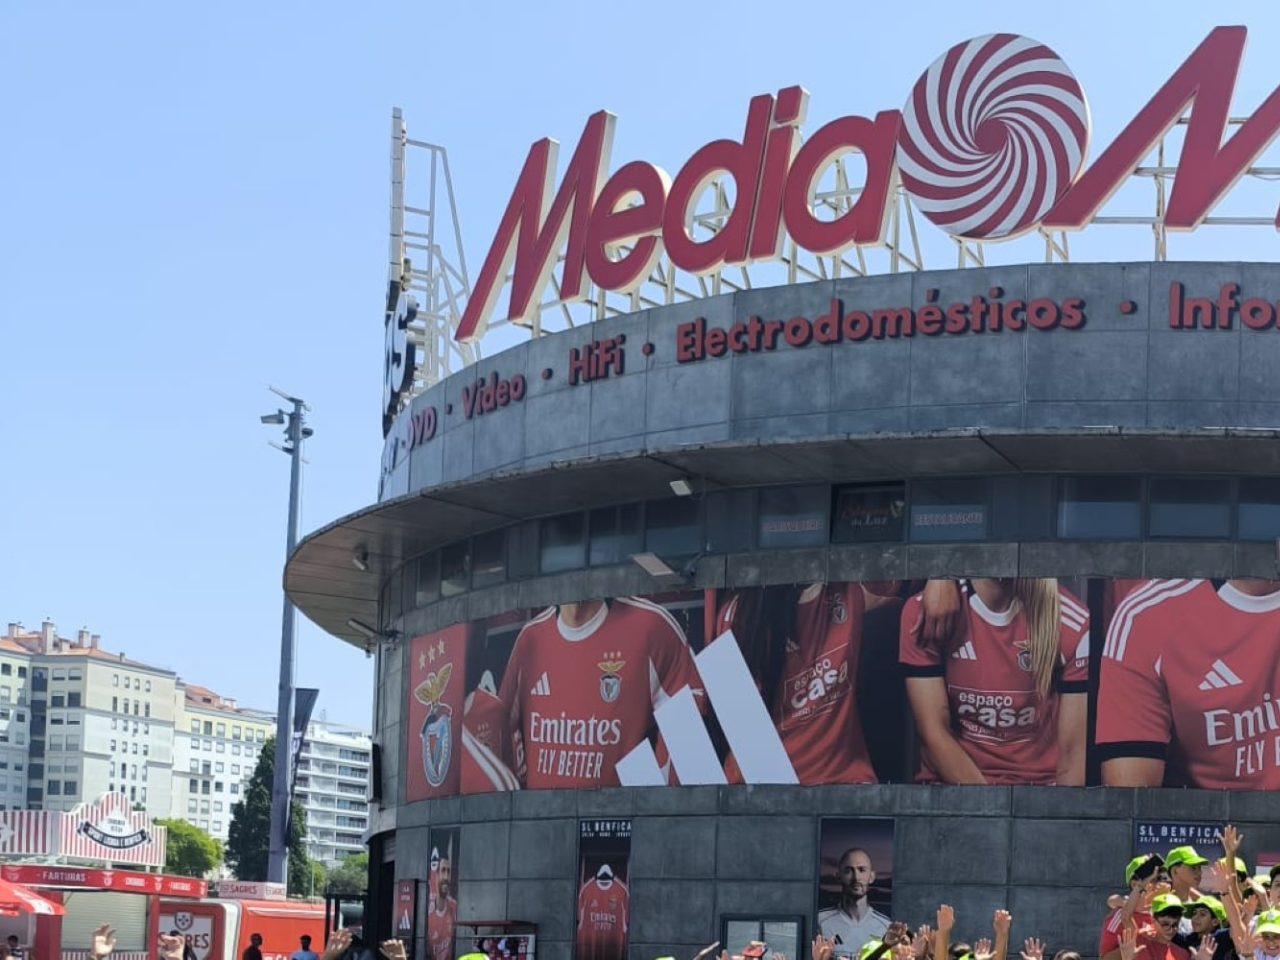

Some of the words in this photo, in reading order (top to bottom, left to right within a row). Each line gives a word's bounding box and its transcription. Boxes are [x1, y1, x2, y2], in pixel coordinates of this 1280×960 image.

[455, 84, 902, 341] Media
[568, 334, 625, 386] HiFi
[676, 288, 1086, 363] Electrodomésticos
[958, 704, 1036, 727] casa
[959, 692, 1013, 709] espaço
[530, 711, 621, 746] Emirates
[537, 748, 556, 775] FLY
[557, 750, 603, 778] BETTER
[1235, 740, 1265, 777] FLY
[581, 821, 591, 832] SL
[595, 821, 632, 833] BENFICA
[1139, 825, 1154, 836] SL
[1161, 826, 1221, 838] BENFICA
